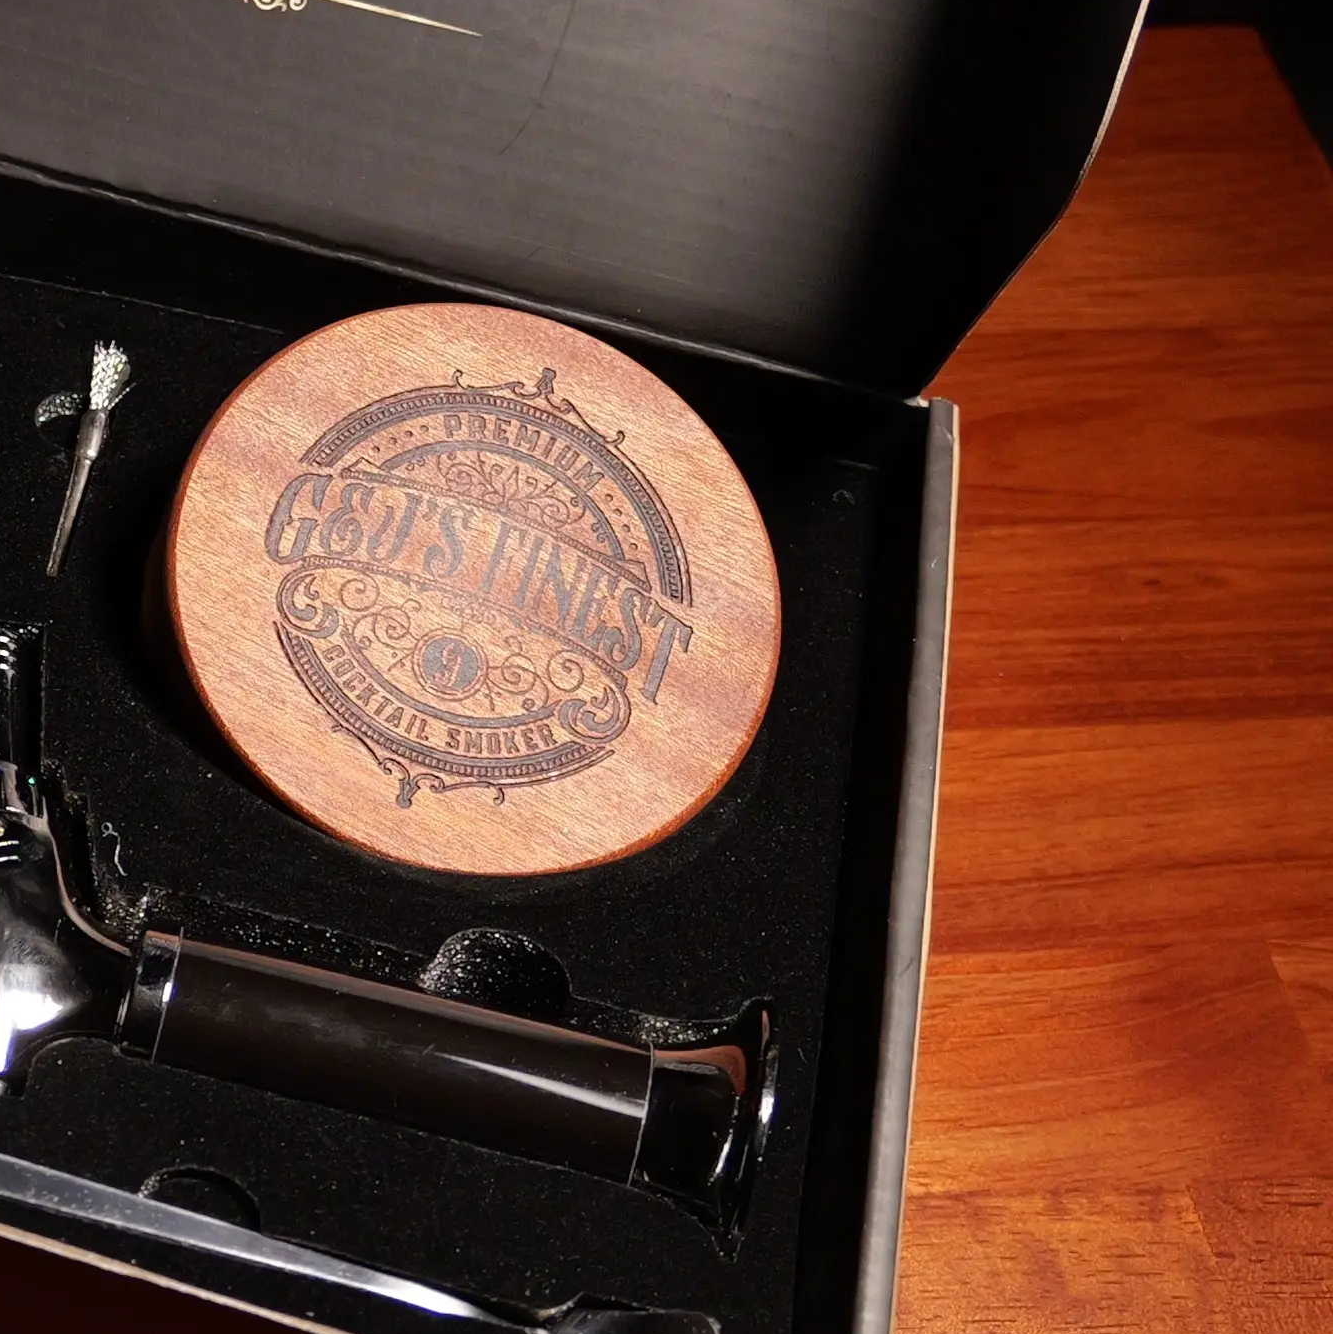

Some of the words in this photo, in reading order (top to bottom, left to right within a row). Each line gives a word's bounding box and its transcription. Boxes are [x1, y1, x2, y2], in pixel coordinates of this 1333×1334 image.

[442, 413, 606, 491] PREMIUM
[480, 510, 694, 705] FINEST
[321, 643, 431, 742] COCKTAIL
[444, 720, 558, 757] SMOKER
